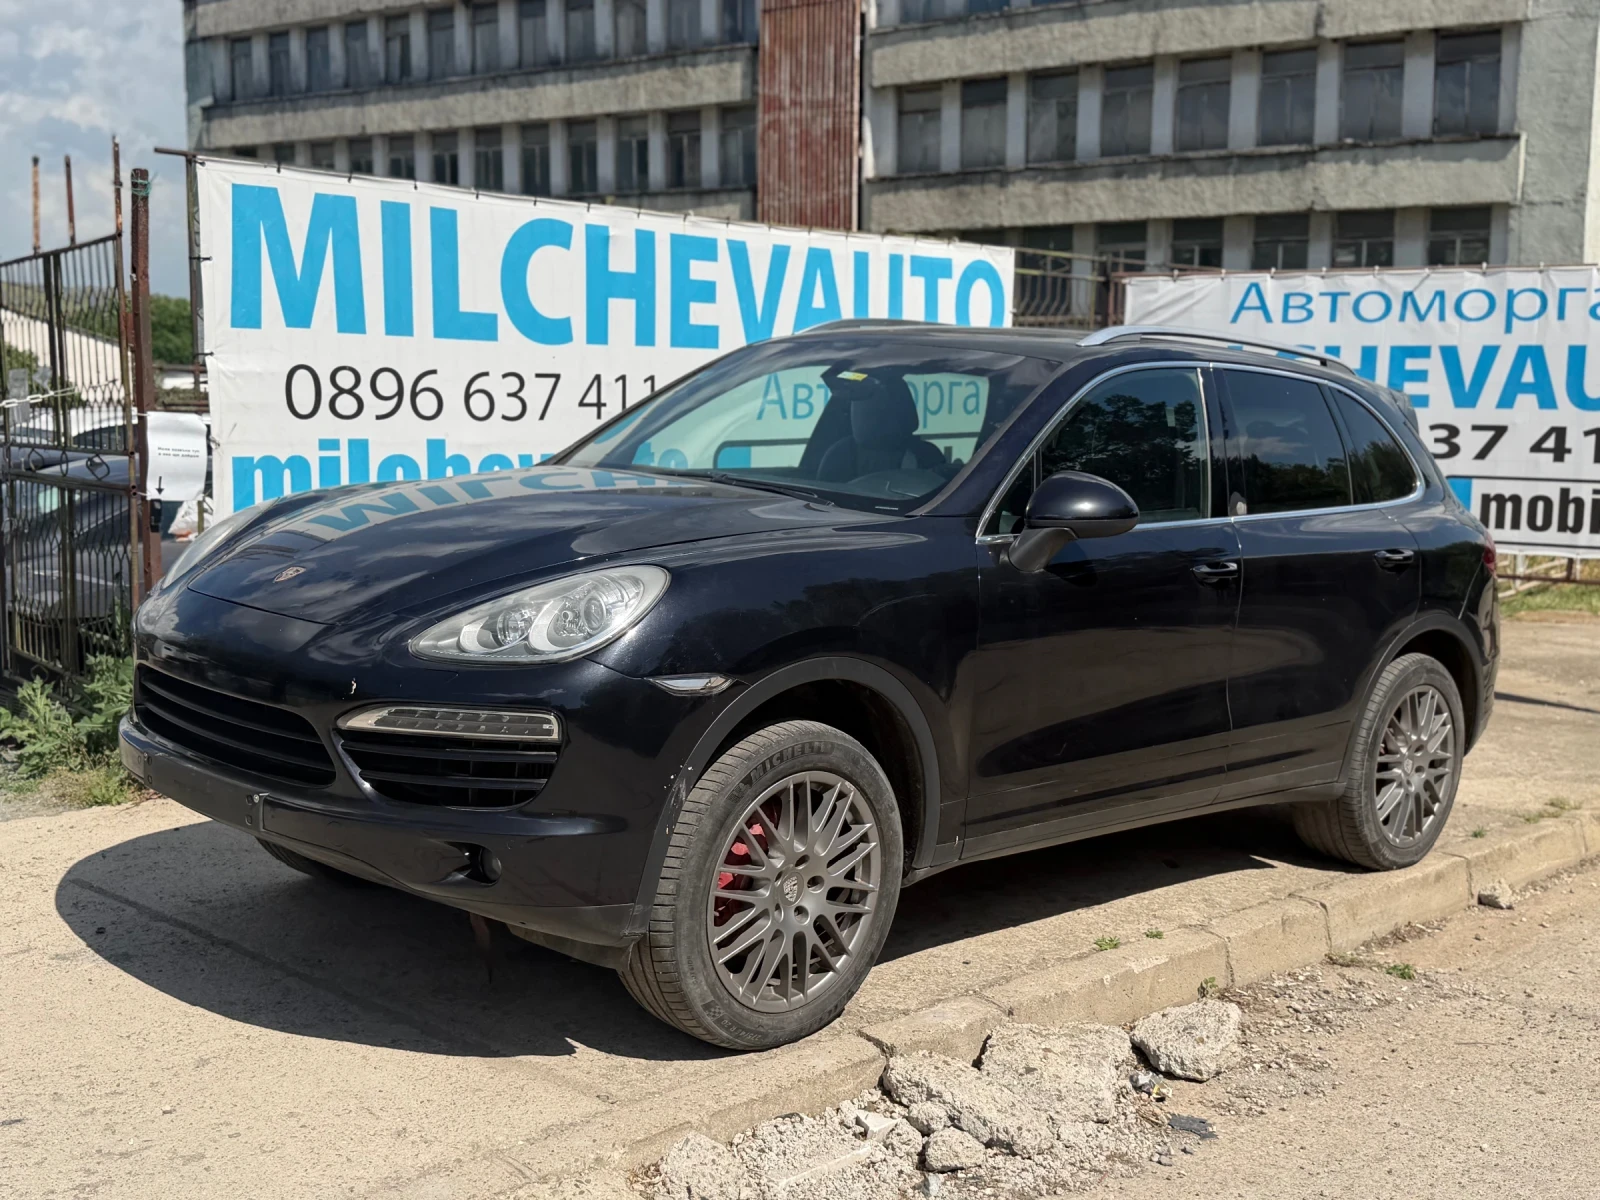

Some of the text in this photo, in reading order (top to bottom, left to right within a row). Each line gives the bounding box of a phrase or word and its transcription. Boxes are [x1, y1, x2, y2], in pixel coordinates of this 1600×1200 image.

[231, 183, 1006, 349] MILCHEVAUTO
[285, 364, 444, 421] 0896
[463, 371, 561, 421] 637
[1479, 487, 1600, 535] mobi
